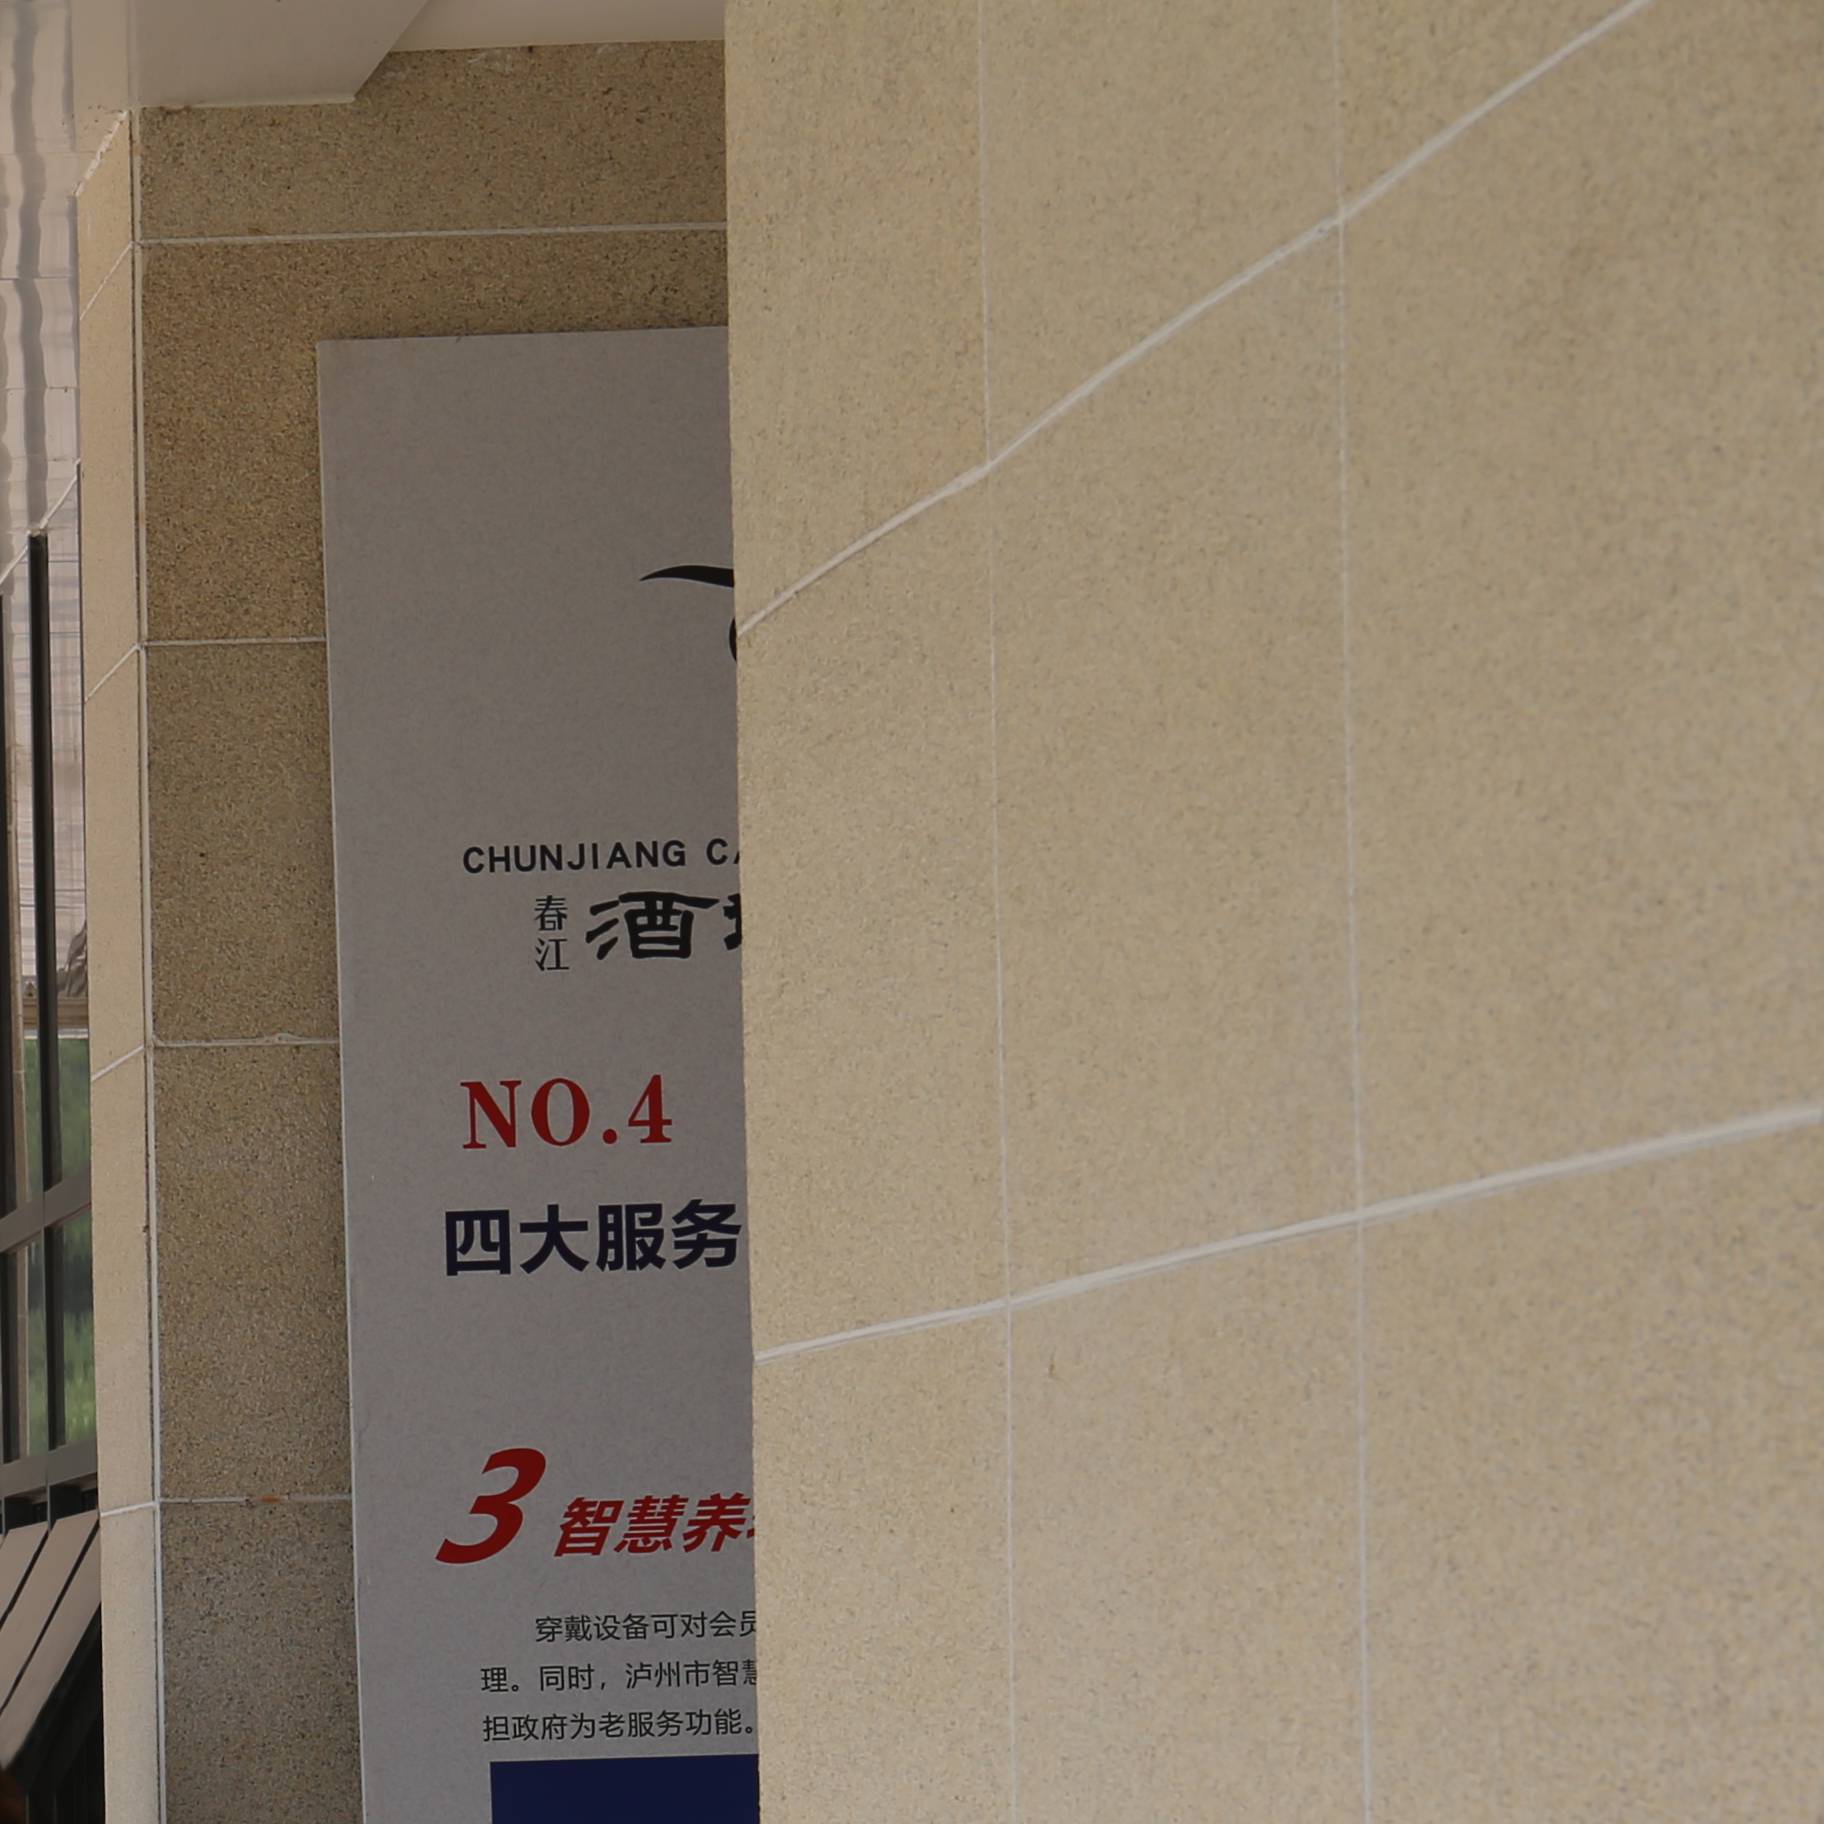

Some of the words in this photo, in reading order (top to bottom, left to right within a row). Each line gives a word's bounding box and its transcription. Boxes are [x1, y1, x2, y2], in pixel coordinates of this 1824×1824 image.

[462, 839, 687, 874] CHUNJIANG
[705, 838, 741, 866] C
[534, 895, 569, 971] 春江
[460, 1074, 673, 1149] NO.4
[445, 1198, 742, 1277] 四大服务
[435, 1447, 547, 1565] 3
[554, 1491, 755, 1557] 智慧养
[482, 1708, 754, 1742] 担政府为老服务功能。
